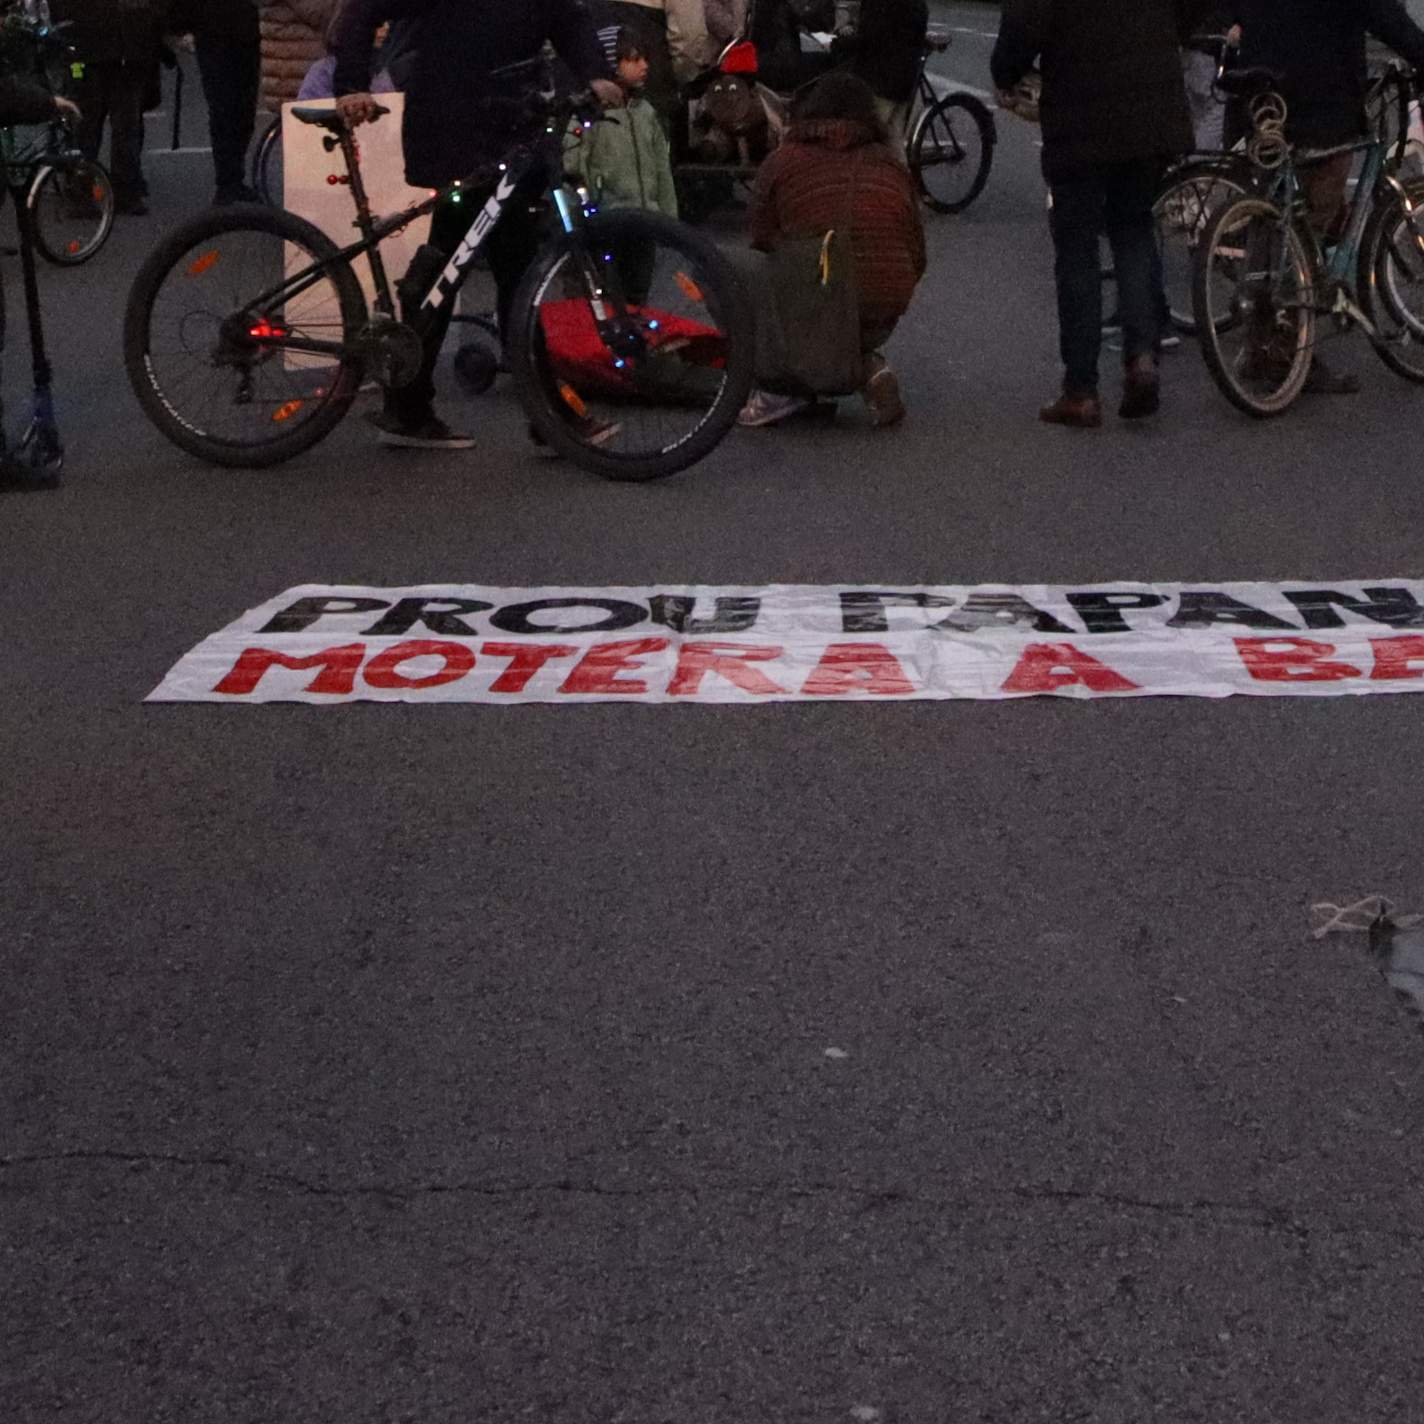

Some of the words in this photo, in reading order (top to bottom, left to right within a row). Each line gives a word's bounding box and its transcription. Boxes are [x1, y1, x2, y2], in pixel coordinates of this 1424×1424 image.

[419, 173, 516, 310] TREK
[258, 595, 761, 635] PROU
[212, 637, 916, 694] MOTERA
[1000, 642, 1144, 691] A
